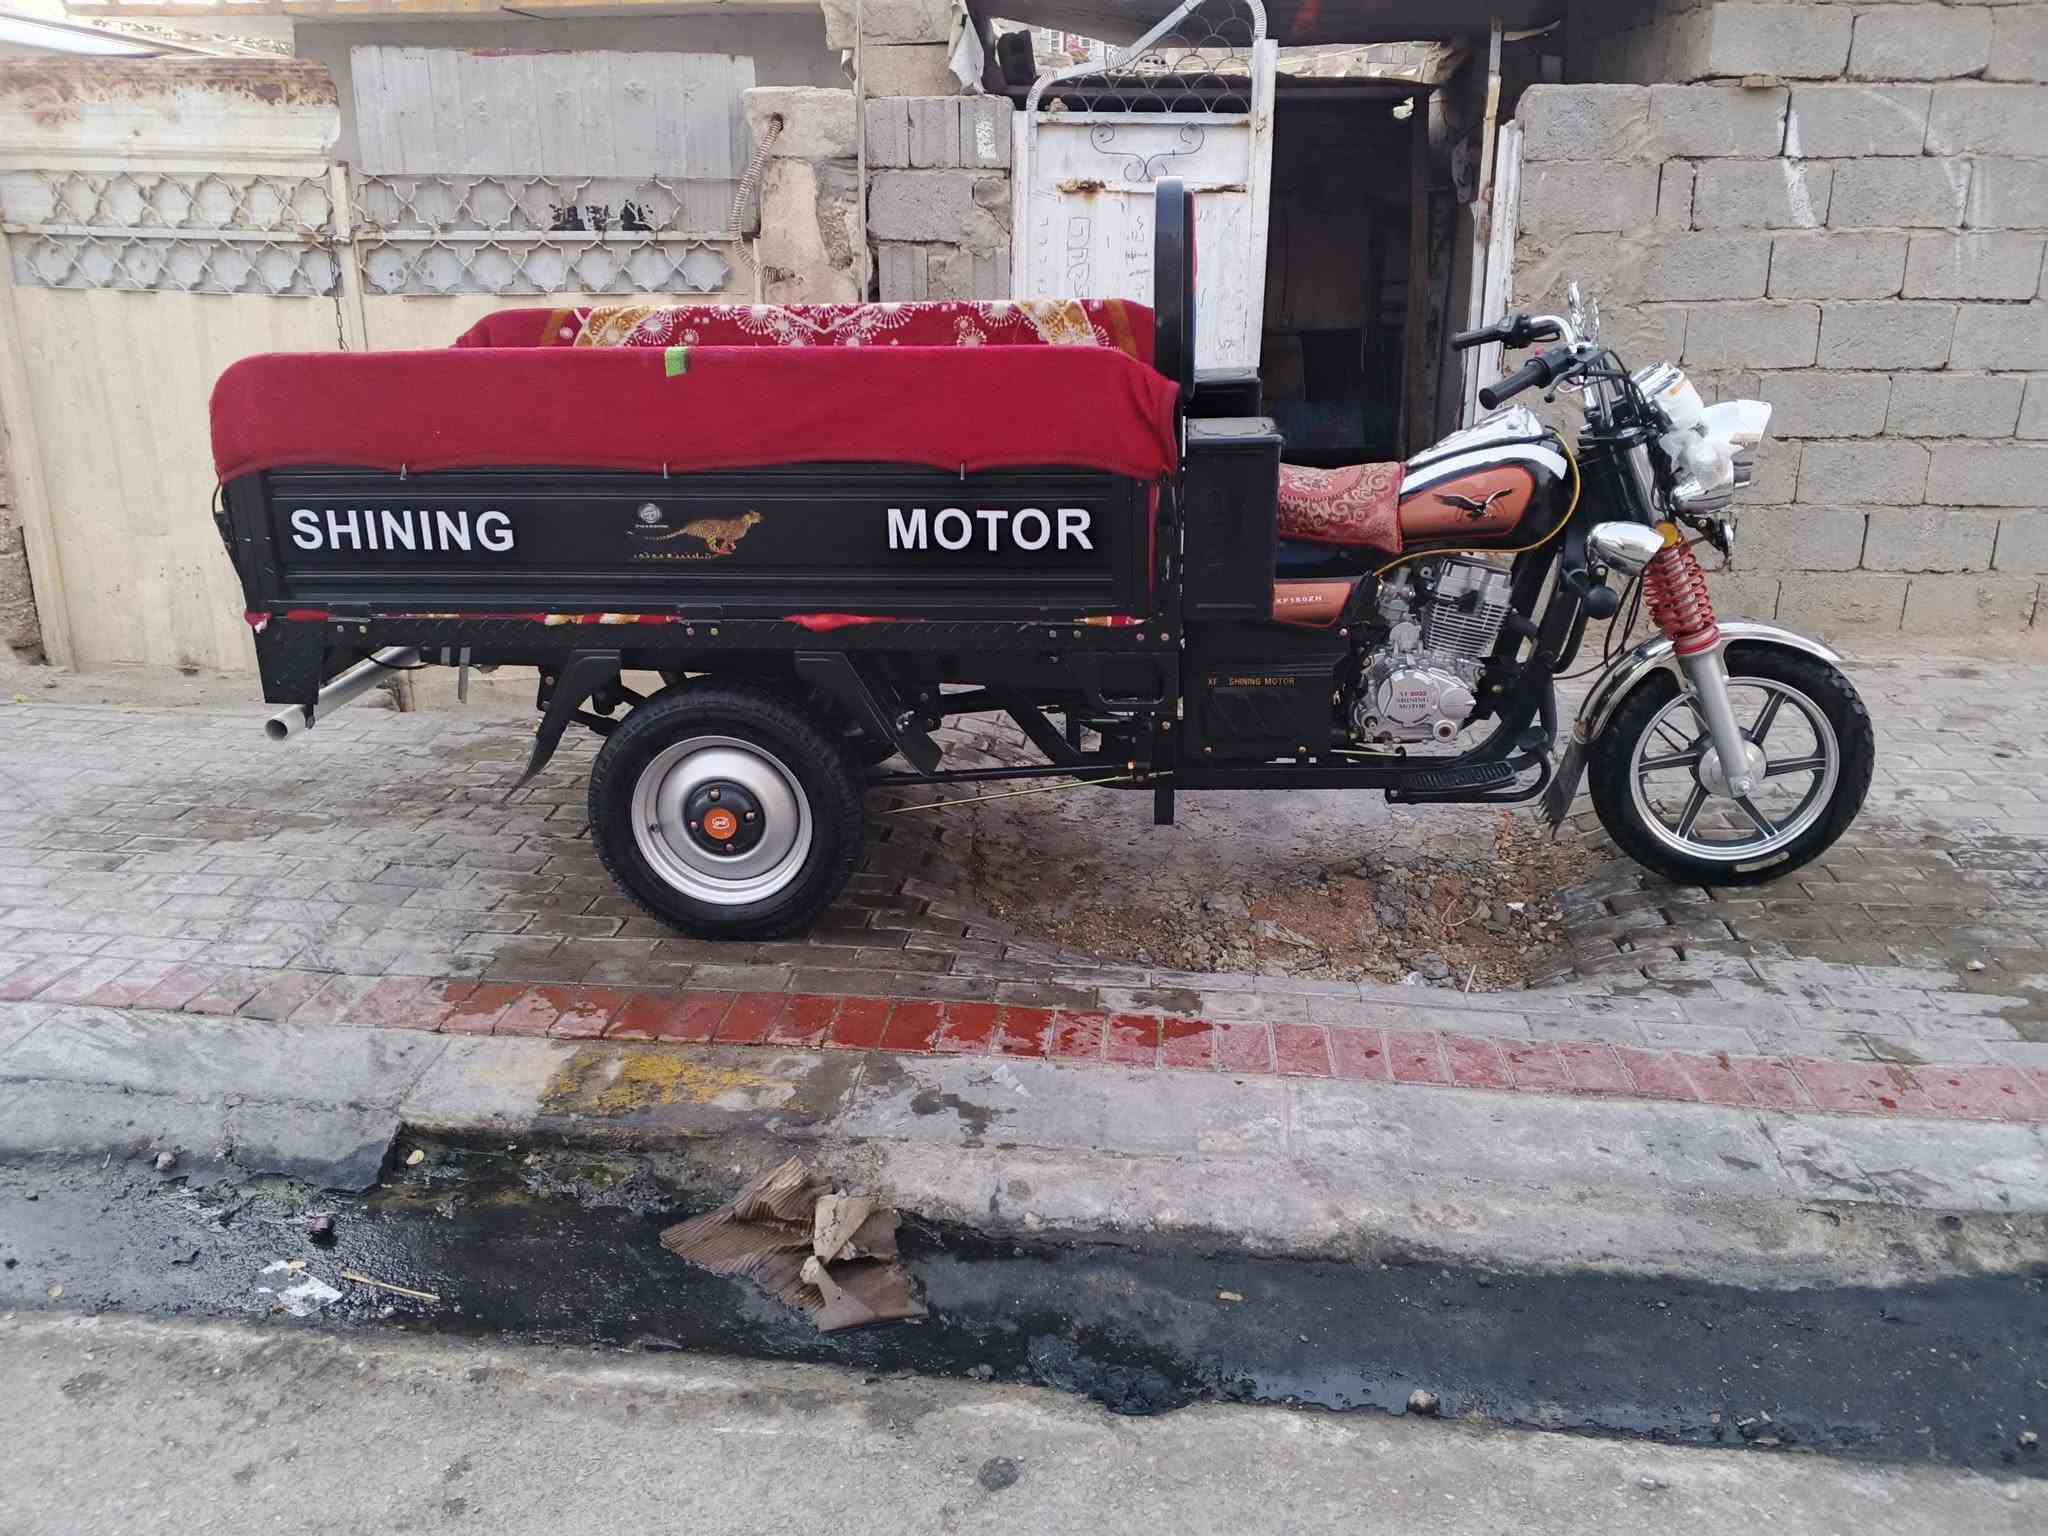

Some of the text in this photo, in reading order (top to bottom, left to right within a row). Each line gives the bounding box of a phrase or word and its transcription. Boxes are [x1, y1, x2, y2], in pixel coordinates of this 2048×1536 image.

[291, 508, 1094, 551] SHINING MOTOR
[1228, 677, 1262, 687] SHINING
[1264, 677, 1296, 687] MOTOR
